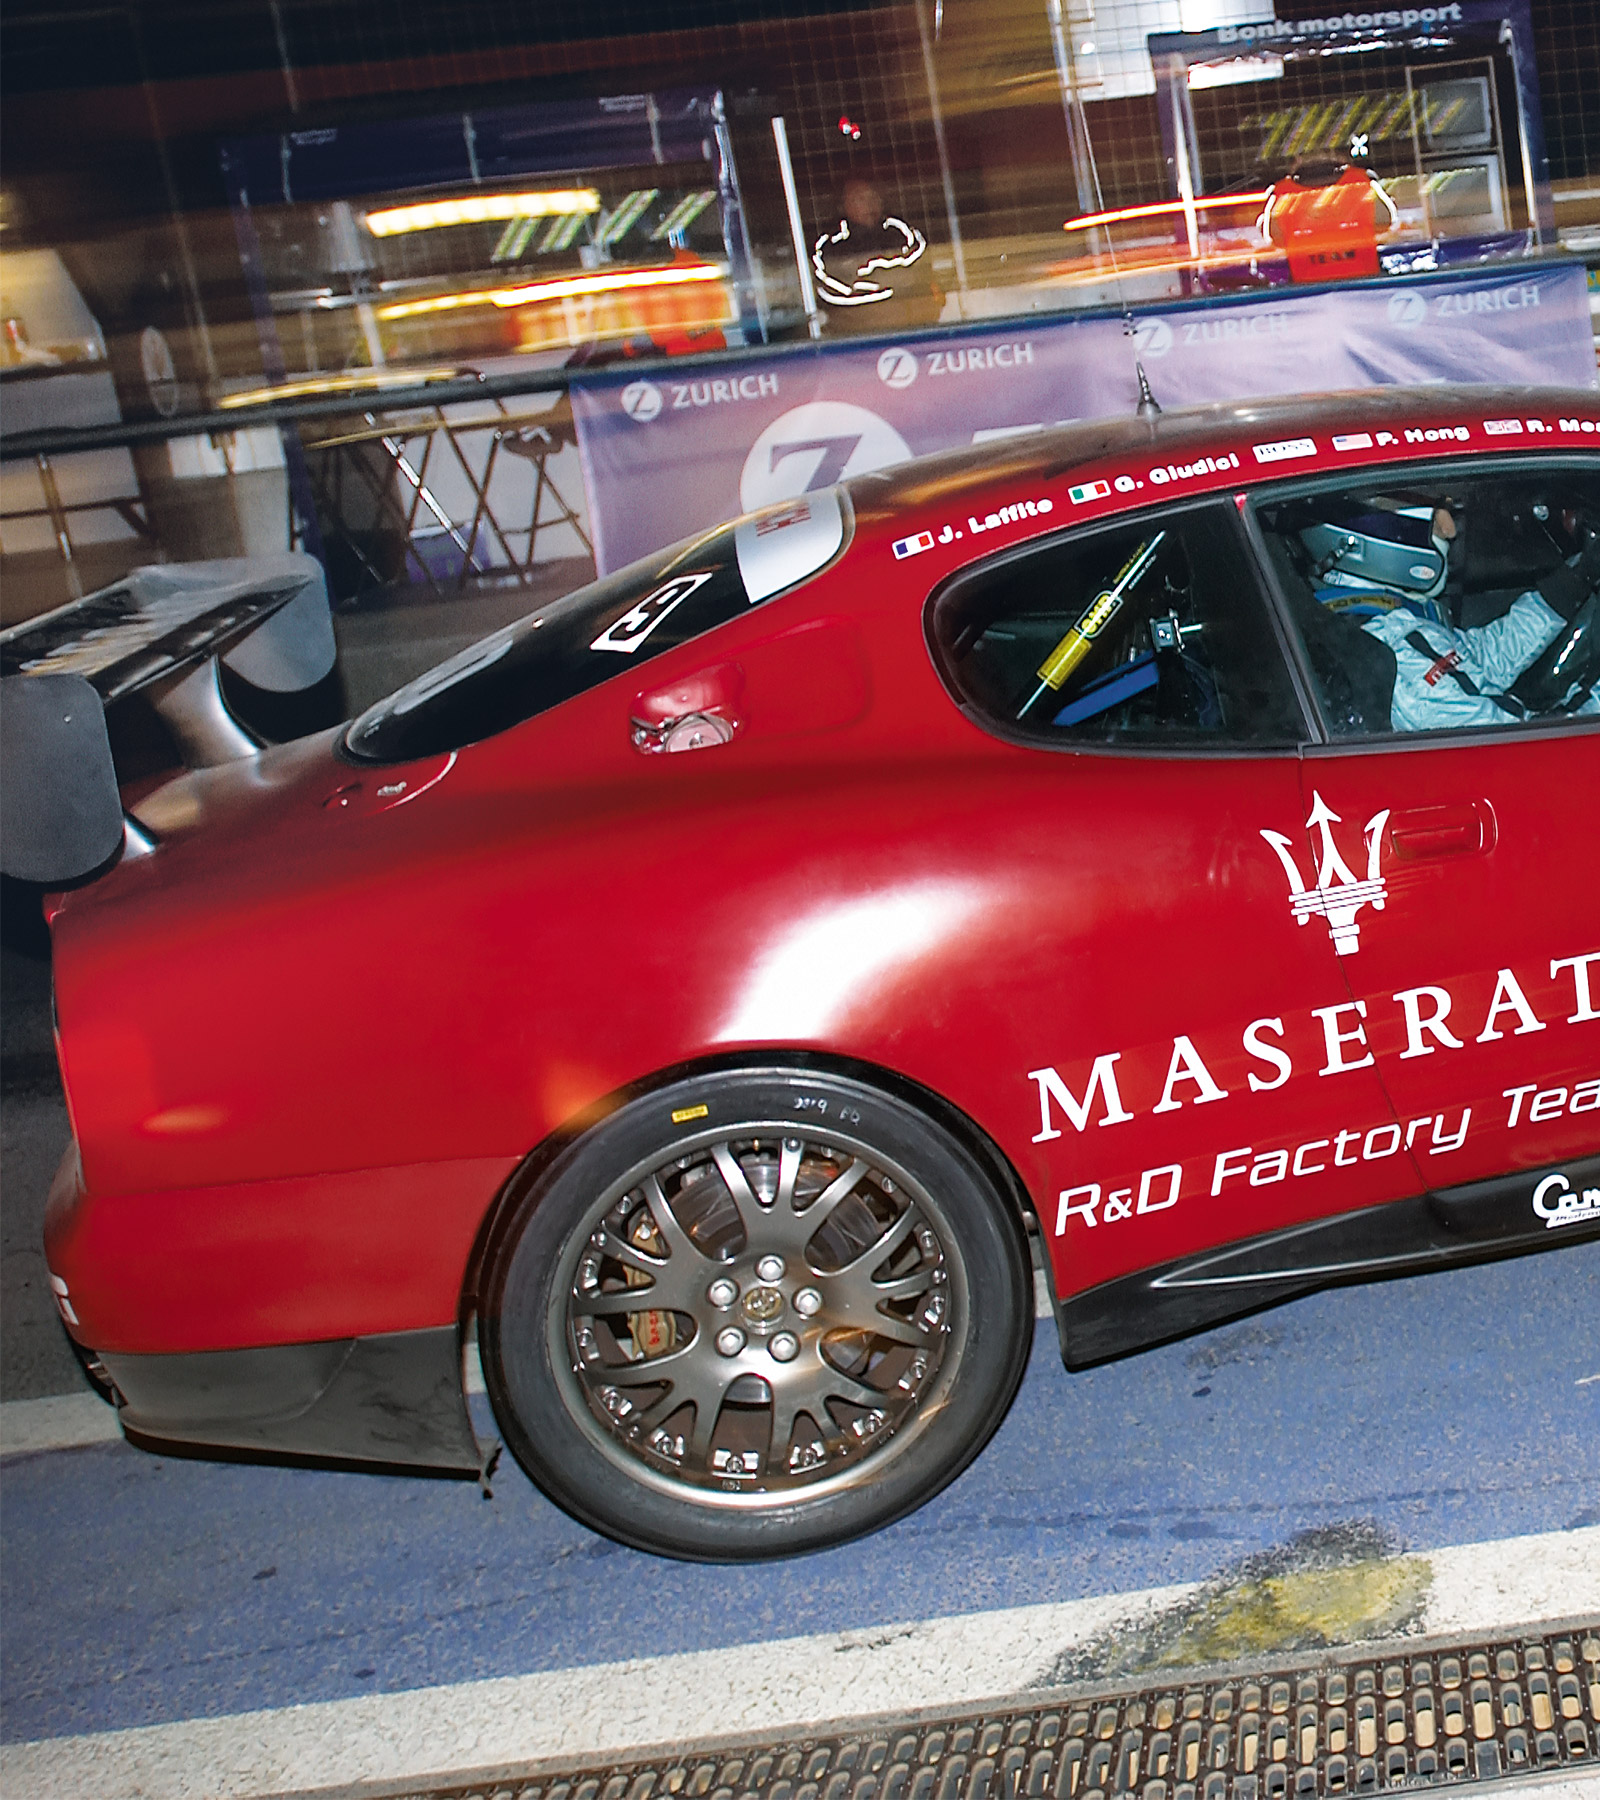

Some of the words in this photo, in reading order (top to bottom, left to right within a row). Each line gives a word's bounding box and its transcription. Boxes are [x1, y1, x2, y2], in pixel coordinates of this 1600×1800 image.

[1217, 18, 1294, 44] Bonk
[1300, 3, 1463, 34] motorsport
[1437, 285, 1541, 318] ZURICH
[1181, 313, 1288, 345] ZURICH
[927, 341, 1034, 378] ZURICH
[671, 373, 780, 411] ZURICH
[1376, 432, 1399, 447] P.
[1404, 425, 1470, 444] Hong
[1526, 419, 1552, 434] R.
[1114, 476, 1144, 493] G.
[938, 525, 963, 544] J.
[1055, 1164, 1185, 1237] R&D
[1210, 1108, 1472, 1197] Factory
